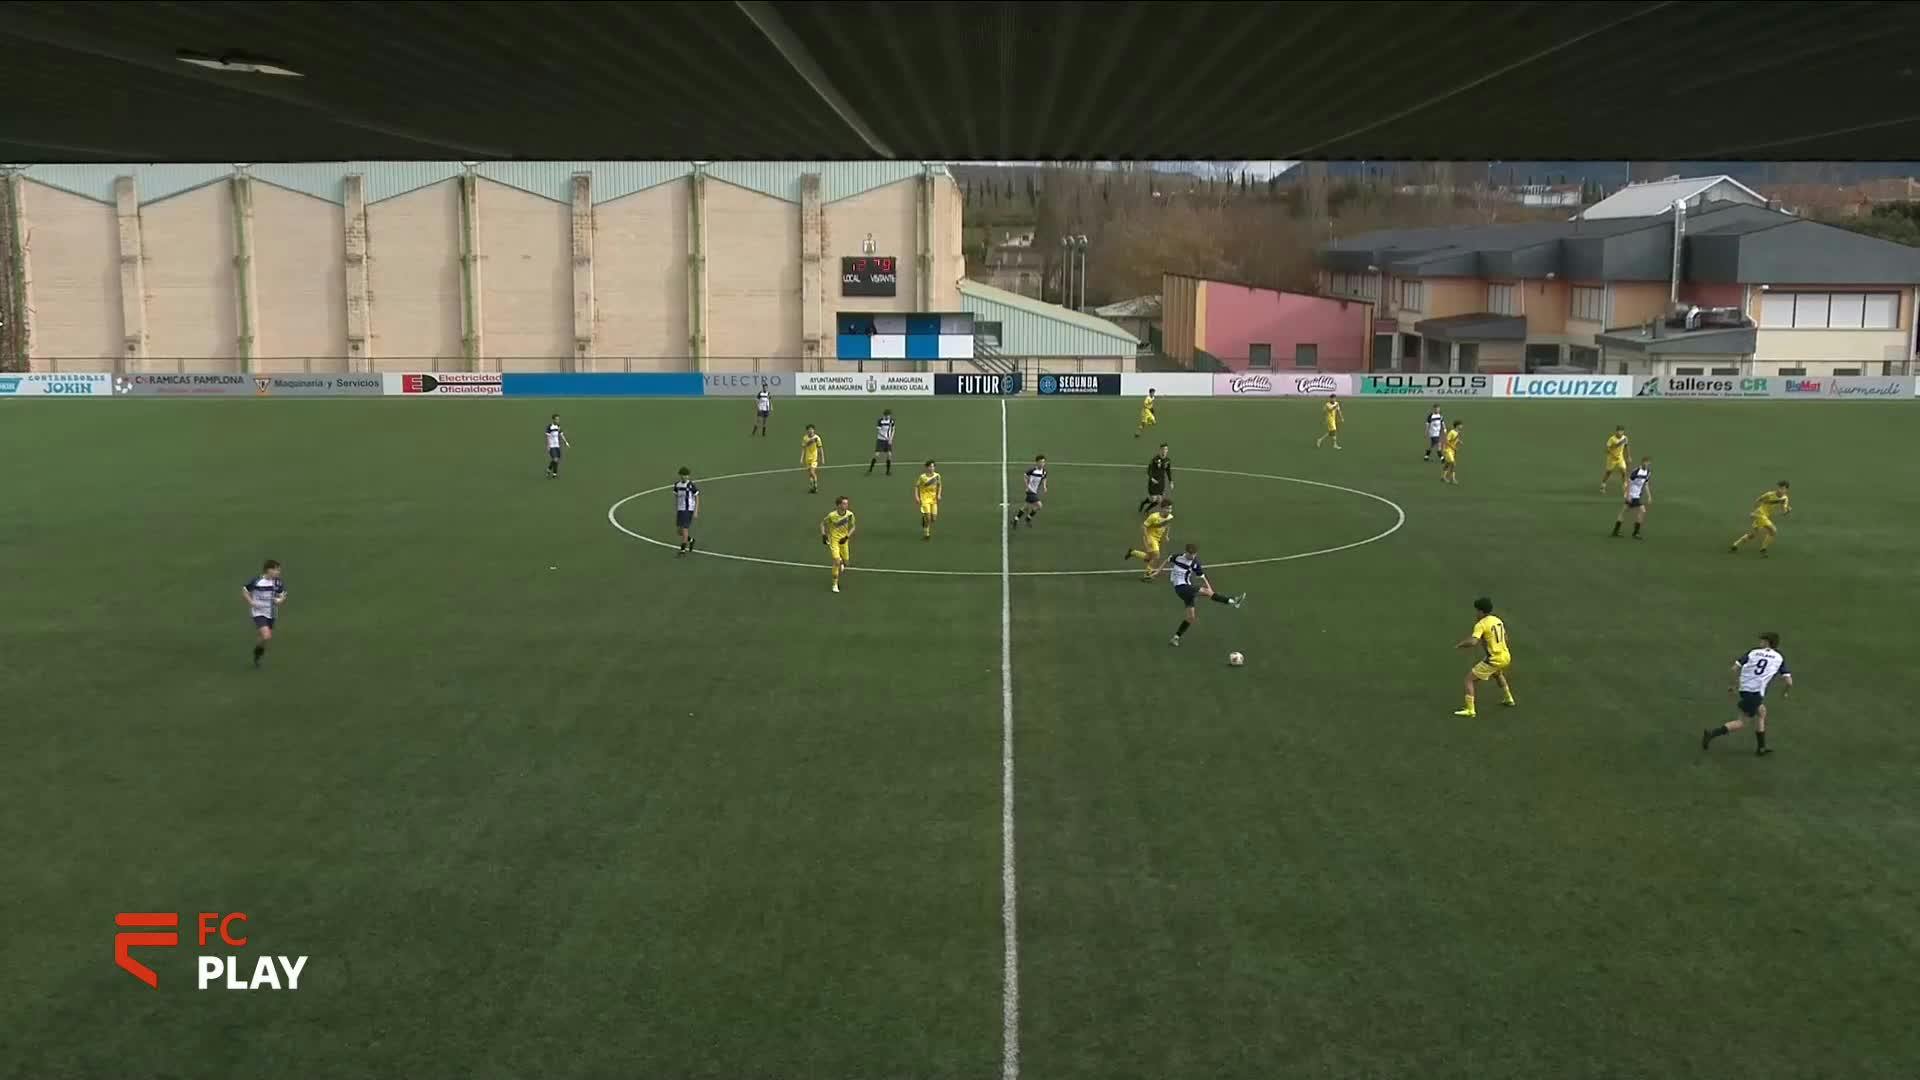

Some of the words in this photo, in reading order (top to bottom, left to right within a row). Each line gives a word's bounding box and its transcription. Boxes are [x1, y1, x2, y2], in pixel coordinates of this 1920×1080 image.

[843, 274, 861, 283] LOCAL
[194, 375, 244, 384] PAMPLONA
[274, 378, 323, 389] Maquinaria
[336, 378, 380, 388] Servicios
[438, 374, 501, 382] Electricidad
[1059, 375, 1098, 388] SEGUNDA
[1367, 376, 1487, 388] TOLDOS
[1669, 377, 1733, 391] talleres
[1740, 377, 1768, 391] CR
[43, 382, 92, 394] JOKIN
[1514, 376, 1617, 396] Lacunza
[1785, 379, 1821, 393] BigMat
[1754, 658, 1768, 675] 9
